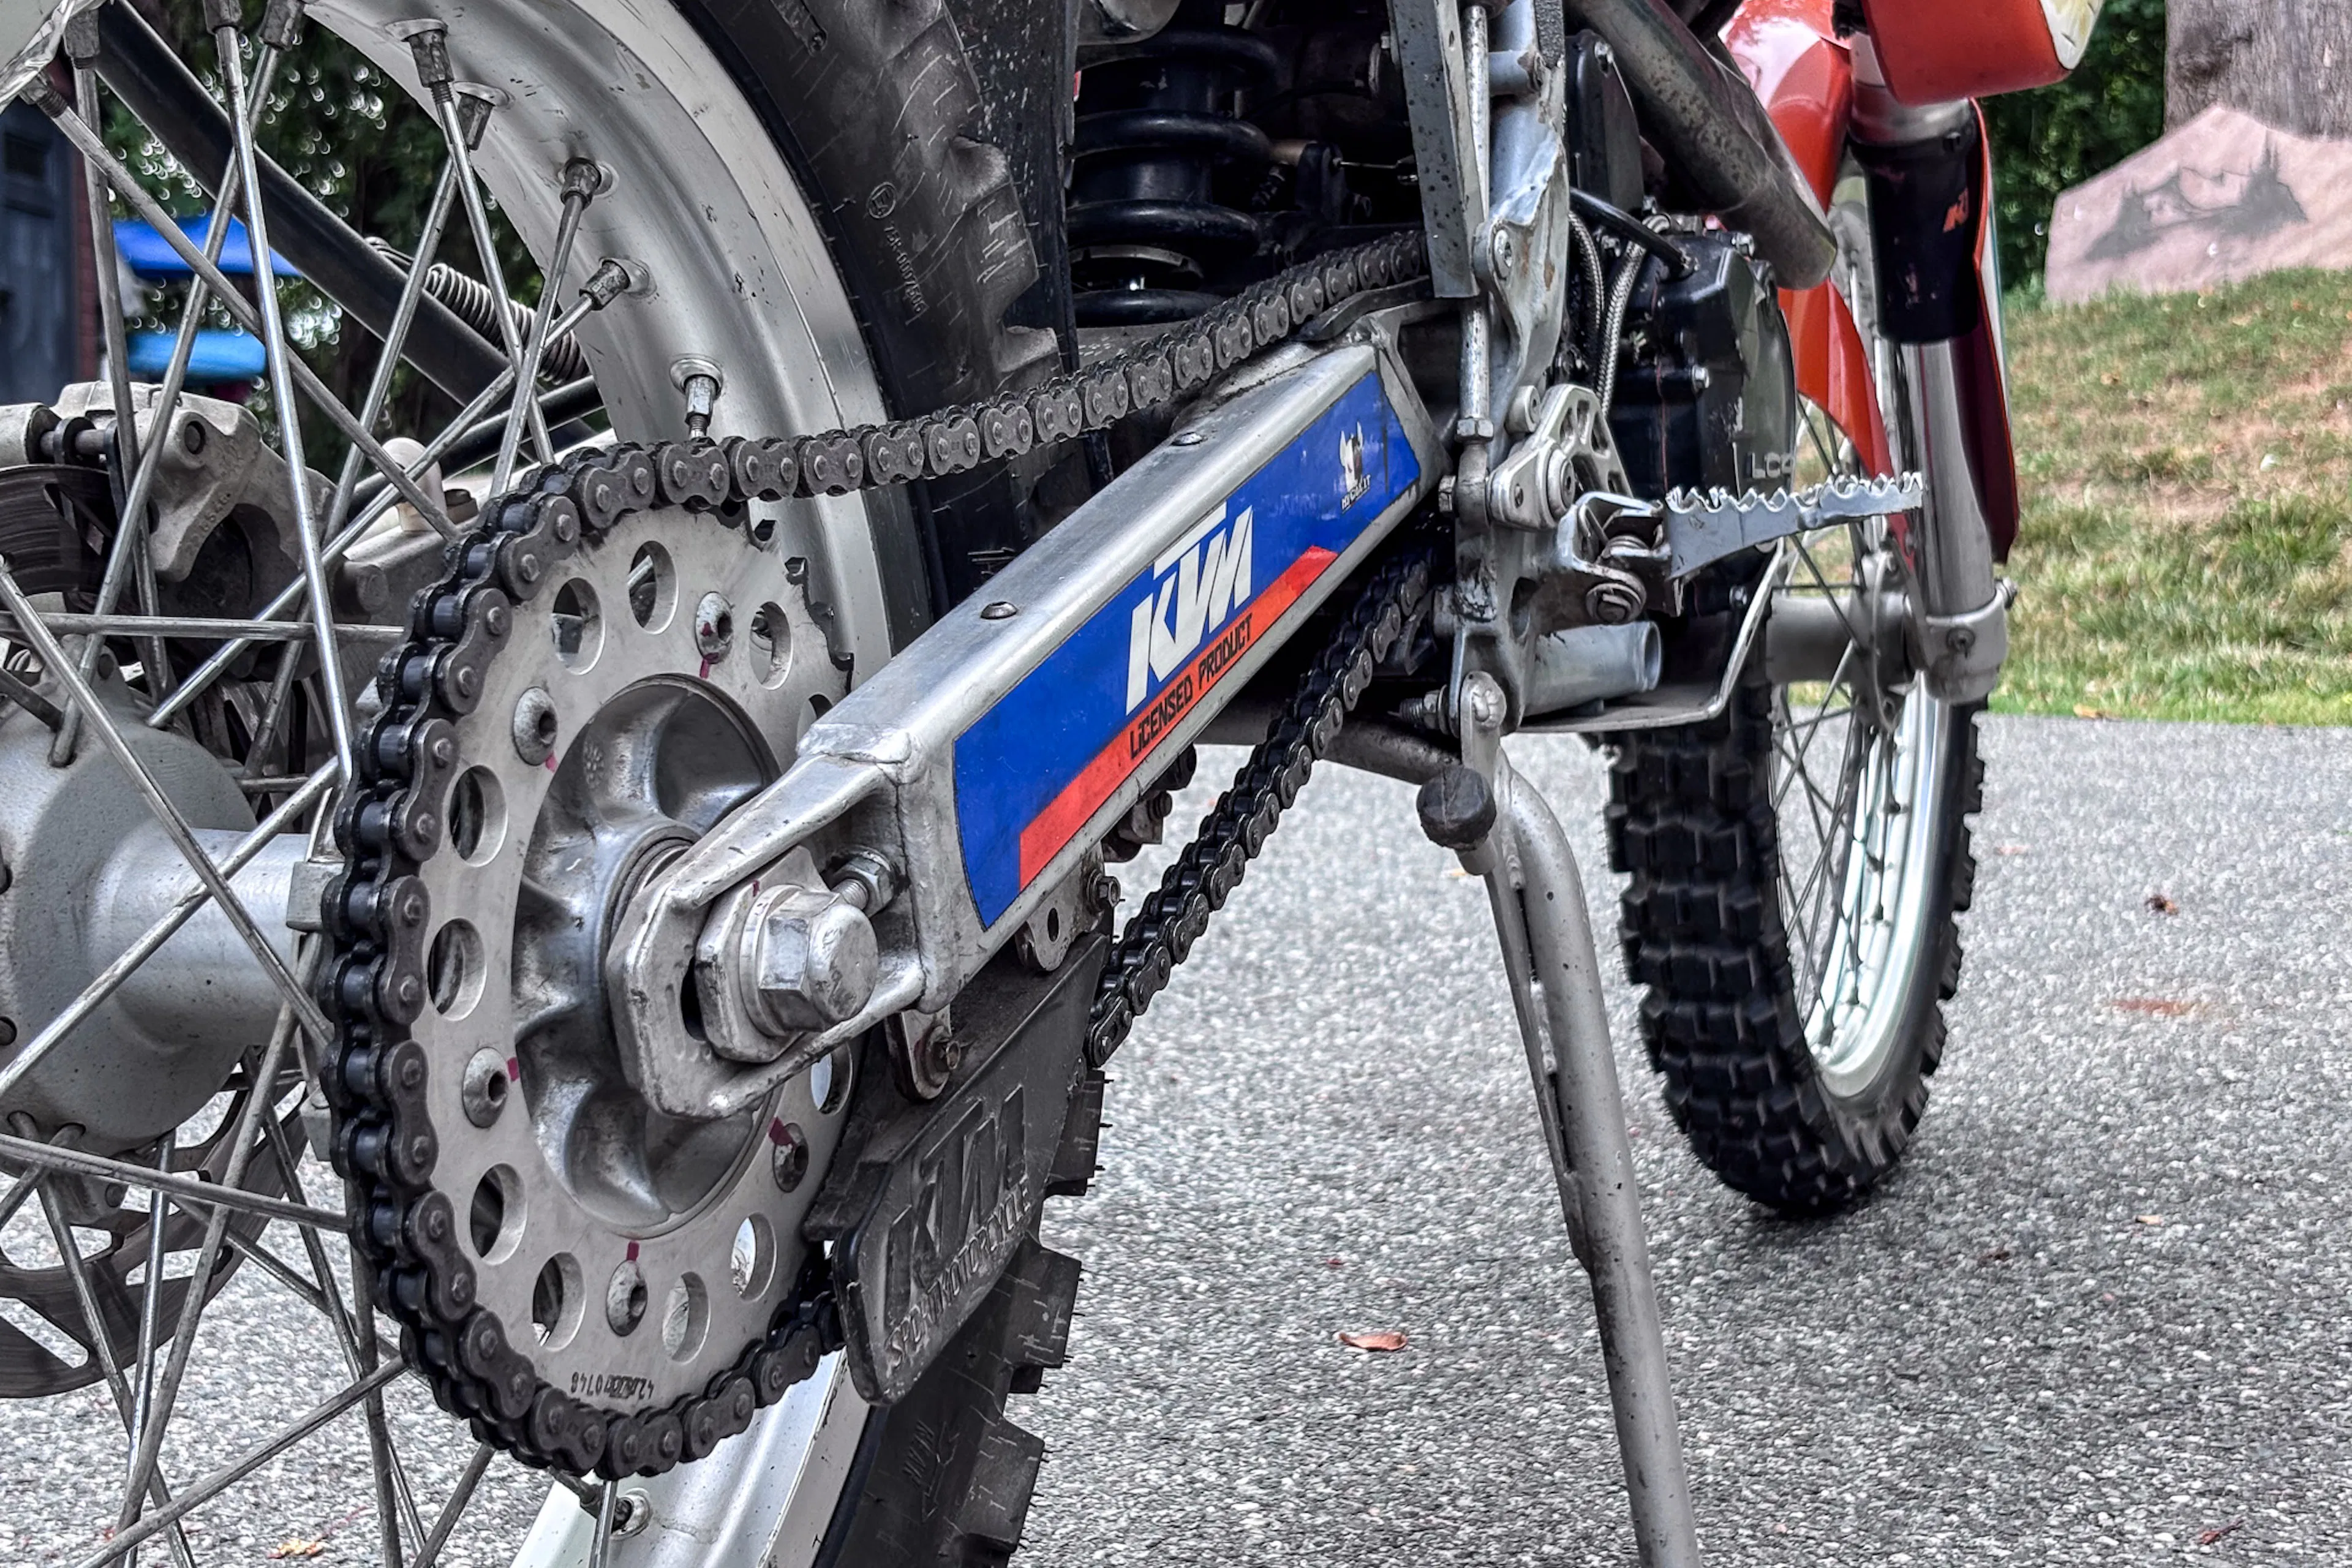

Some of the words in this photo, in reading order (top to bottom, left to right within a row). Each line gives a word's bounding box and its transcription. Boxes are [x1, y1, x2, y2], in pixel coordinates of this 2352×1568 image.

[1126, 501, 1253, 717] KTM
[1198, 612, 1253, 690] PRODUCT
[883, 1083, 1028, 1336] KTM
